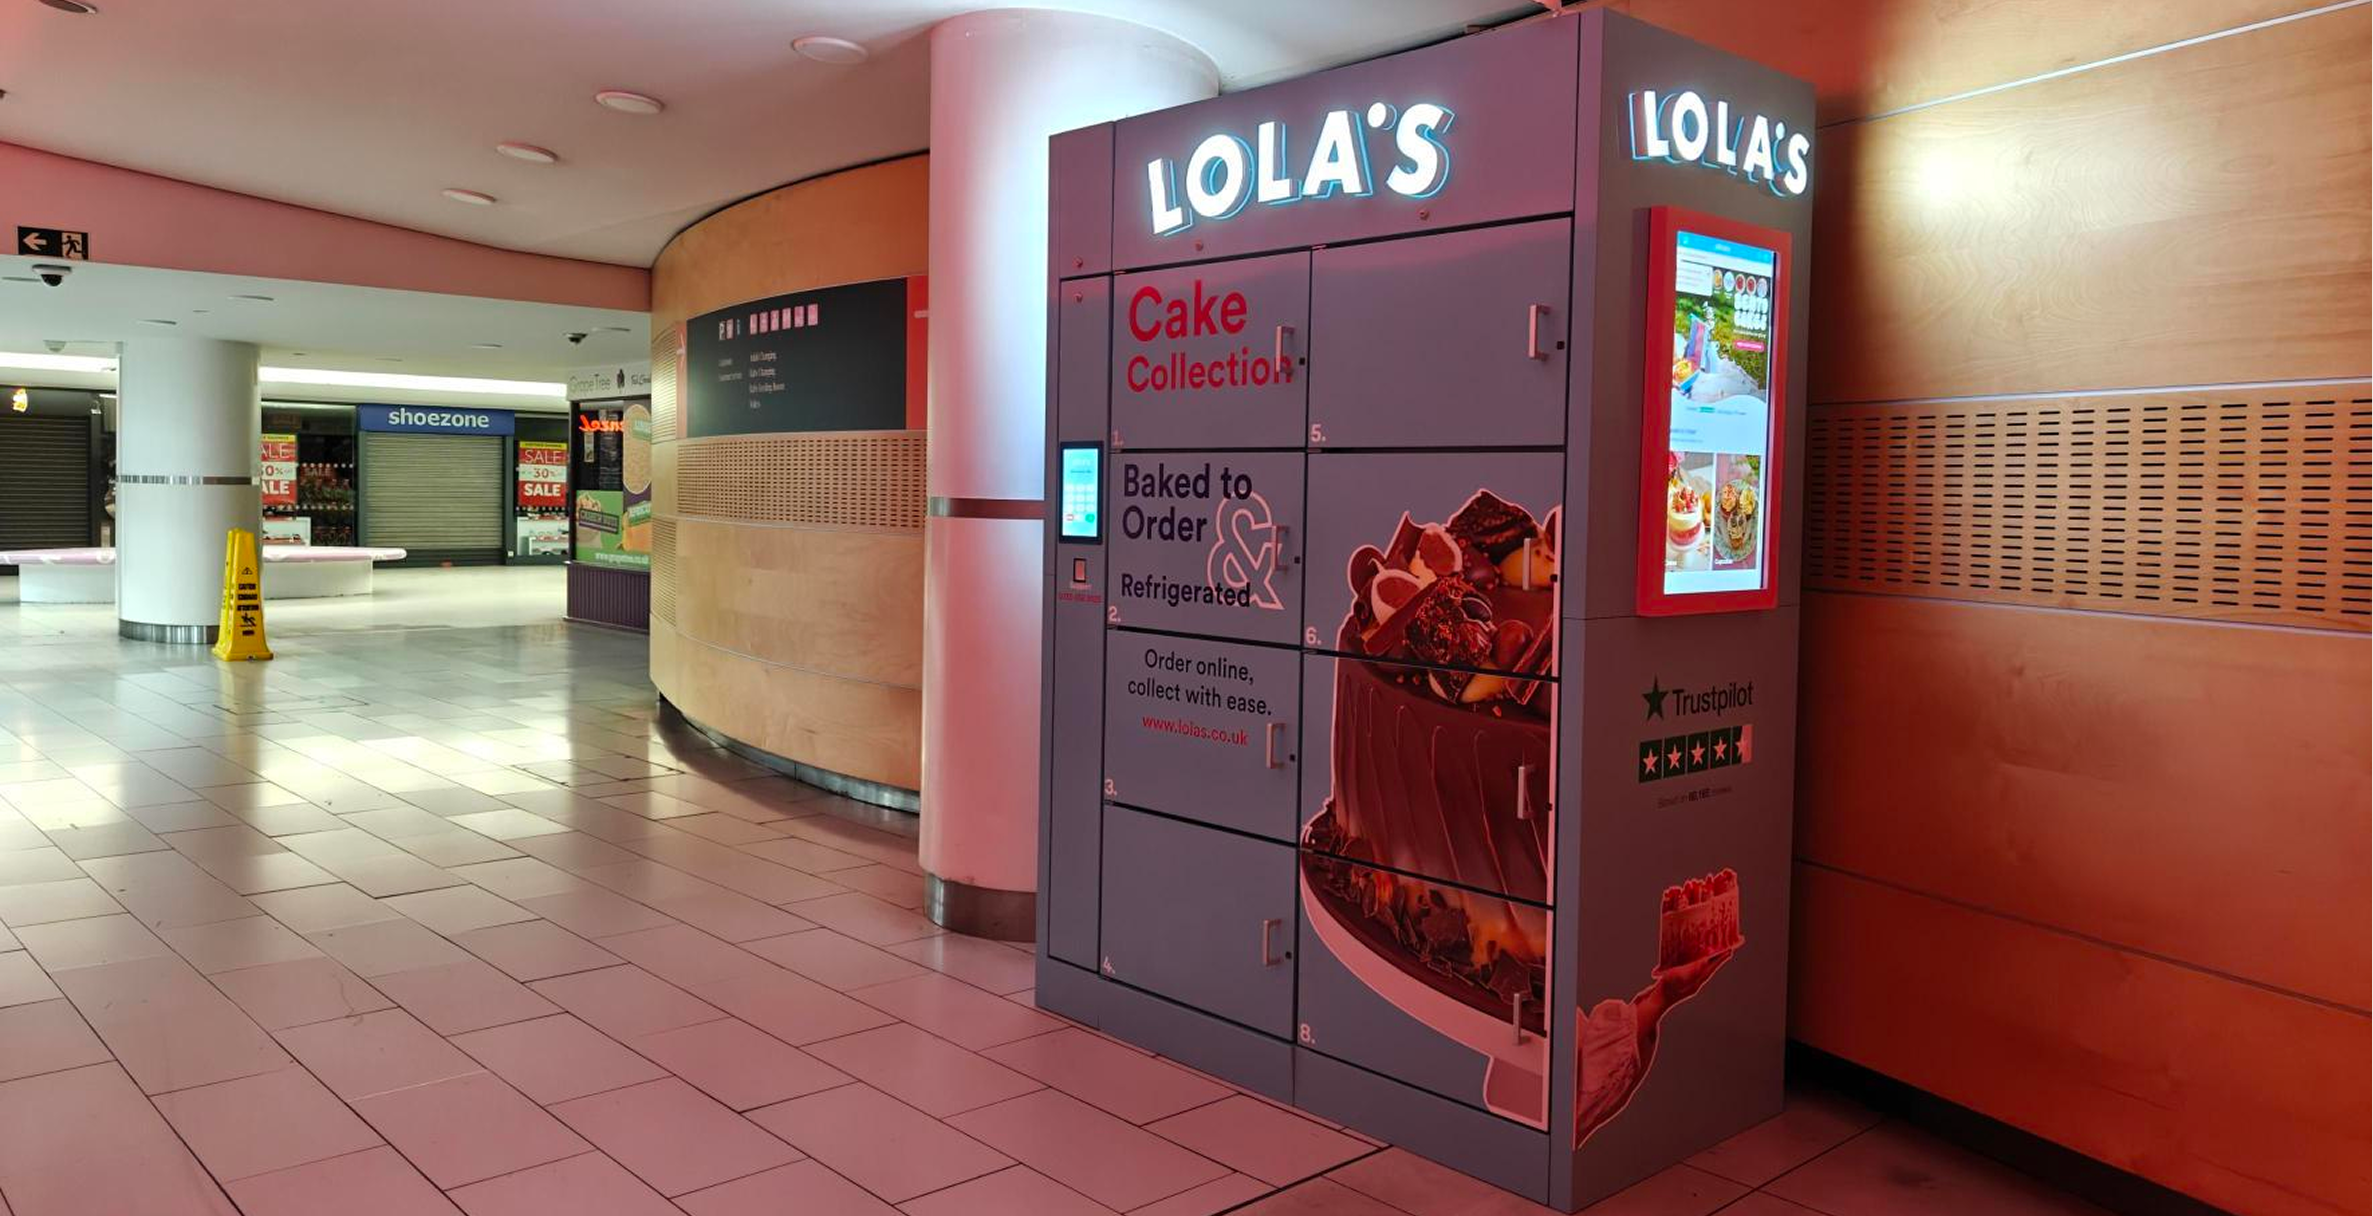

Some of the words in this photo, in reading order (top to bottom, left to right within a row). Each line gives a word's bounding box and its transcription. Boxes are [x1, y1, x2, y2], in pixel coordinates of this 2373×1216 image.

[1630, 90, 1810, 196] LOLA'S
[1148, 102, 1454, 236] LOLA'S
[1129, 280, 1248, 342] Cake
[1127, 347, 1292, 393] Collection
[388, 408, 489, 428] shoezone
[1113, 432, 1124, 446] 1.
[1311, 425, 1326, 442] 5.
[260, 443, 290, 459] ALE
[525, 450, 563, 464] SALE
[261, 481, 290, 495] ALE
[524, 482, 561, 497] SALE
[1124, 463, 1210, 499] Baked
[1221, 467, 1253, 500] to
[1122, 505, 1208, 542] Order
[1121, 573, 1250, 608] Refrigerated
[1108, 607, 1121, 622] 2.
[1305, 627, 1322, 645] 6.
[1145, 649, 1191, 673] Order
[1196, 658, 1253, 685] online,
[1128, 678, 1180, 702] collect
[1186, 686, 1221, 708] with
[1227, 698, 1272, 716] ease.
[1672, 681, 1754, 716] Trustpilot
[1142, 716, 1248, 746] www.lolas.co.uk
[1105, 779, 1117, 795] 3.
[1103, 956, 1116, 974] 4.
[1300, 1024, 1315, 1044] 8.
